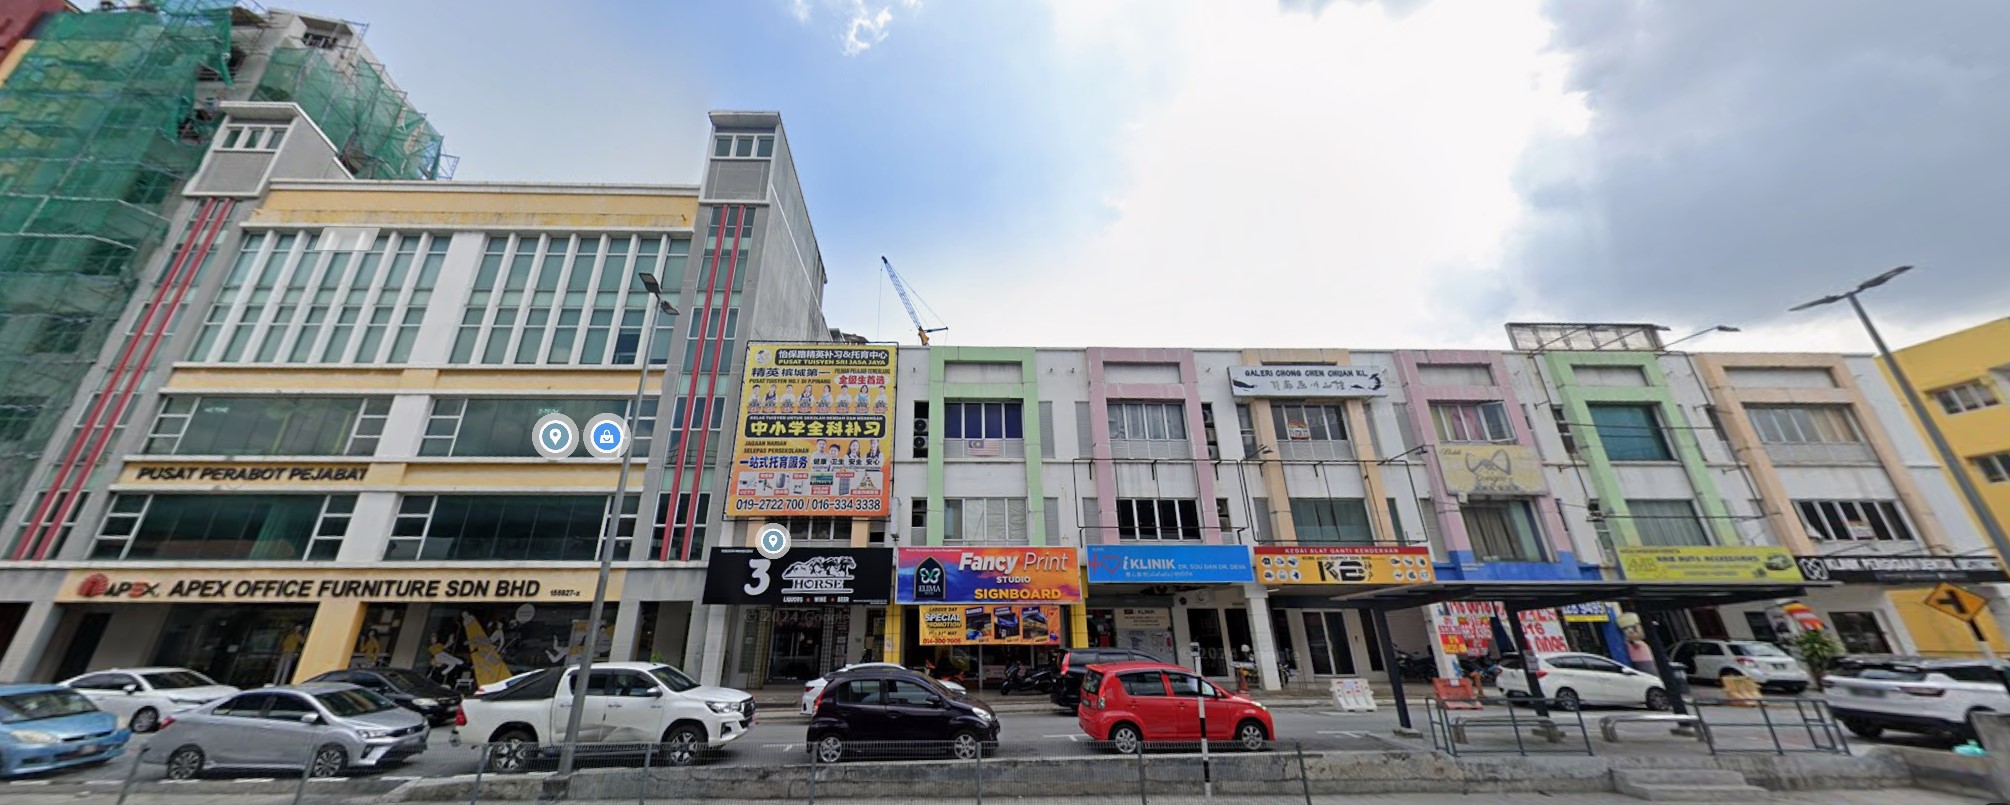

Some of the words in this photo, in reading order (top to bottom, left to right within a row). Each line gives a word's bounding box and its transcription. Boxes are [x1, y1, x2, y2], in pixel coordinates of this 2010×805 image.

[751, 368, 779, 378] 精英
[838, 375, 886, 385] 全级生首选
[751, 421, 881, 437] 中小学全科补习
[739, 456, 808, 469] 一站式托育服务
[813, 458, 827, 466] 健康
[831, 458, 844, 466] 卫生
[848, 458, 862, 466] 安全
[865, 458, 880, 466] 安心
[136, 467, 196, 480] PUSAT
[199, 467, 284, 480] PERABOT
[288, 467, 368, 481] PEJABAT
[736, 499, 783, 510] 019-2722
[786, 499, 805, 510] 700
[812, 499, 854, 510] 016-334
[856, 499, 881, 510] 3338
[958, 552, 1019, 575] Fancy
[1023, 552, 1069, 573] Print
[744, 558, 771, 596] 3
[996, 576, 1031, 584] STUDIO
[167, 580, 232, 598] APEX
[233, 580, 315, 598] OFFICE
[317, 580, 440, 598] FURNITURE
[445, 580, 490, 598] SDN
[495, 580, 541, 598] BHD
[793, 579, 844, 589] HORSE
[974, 588, 1062, 600] SIGNBOARD
[924, 613, 961, 622] SPECIAL
